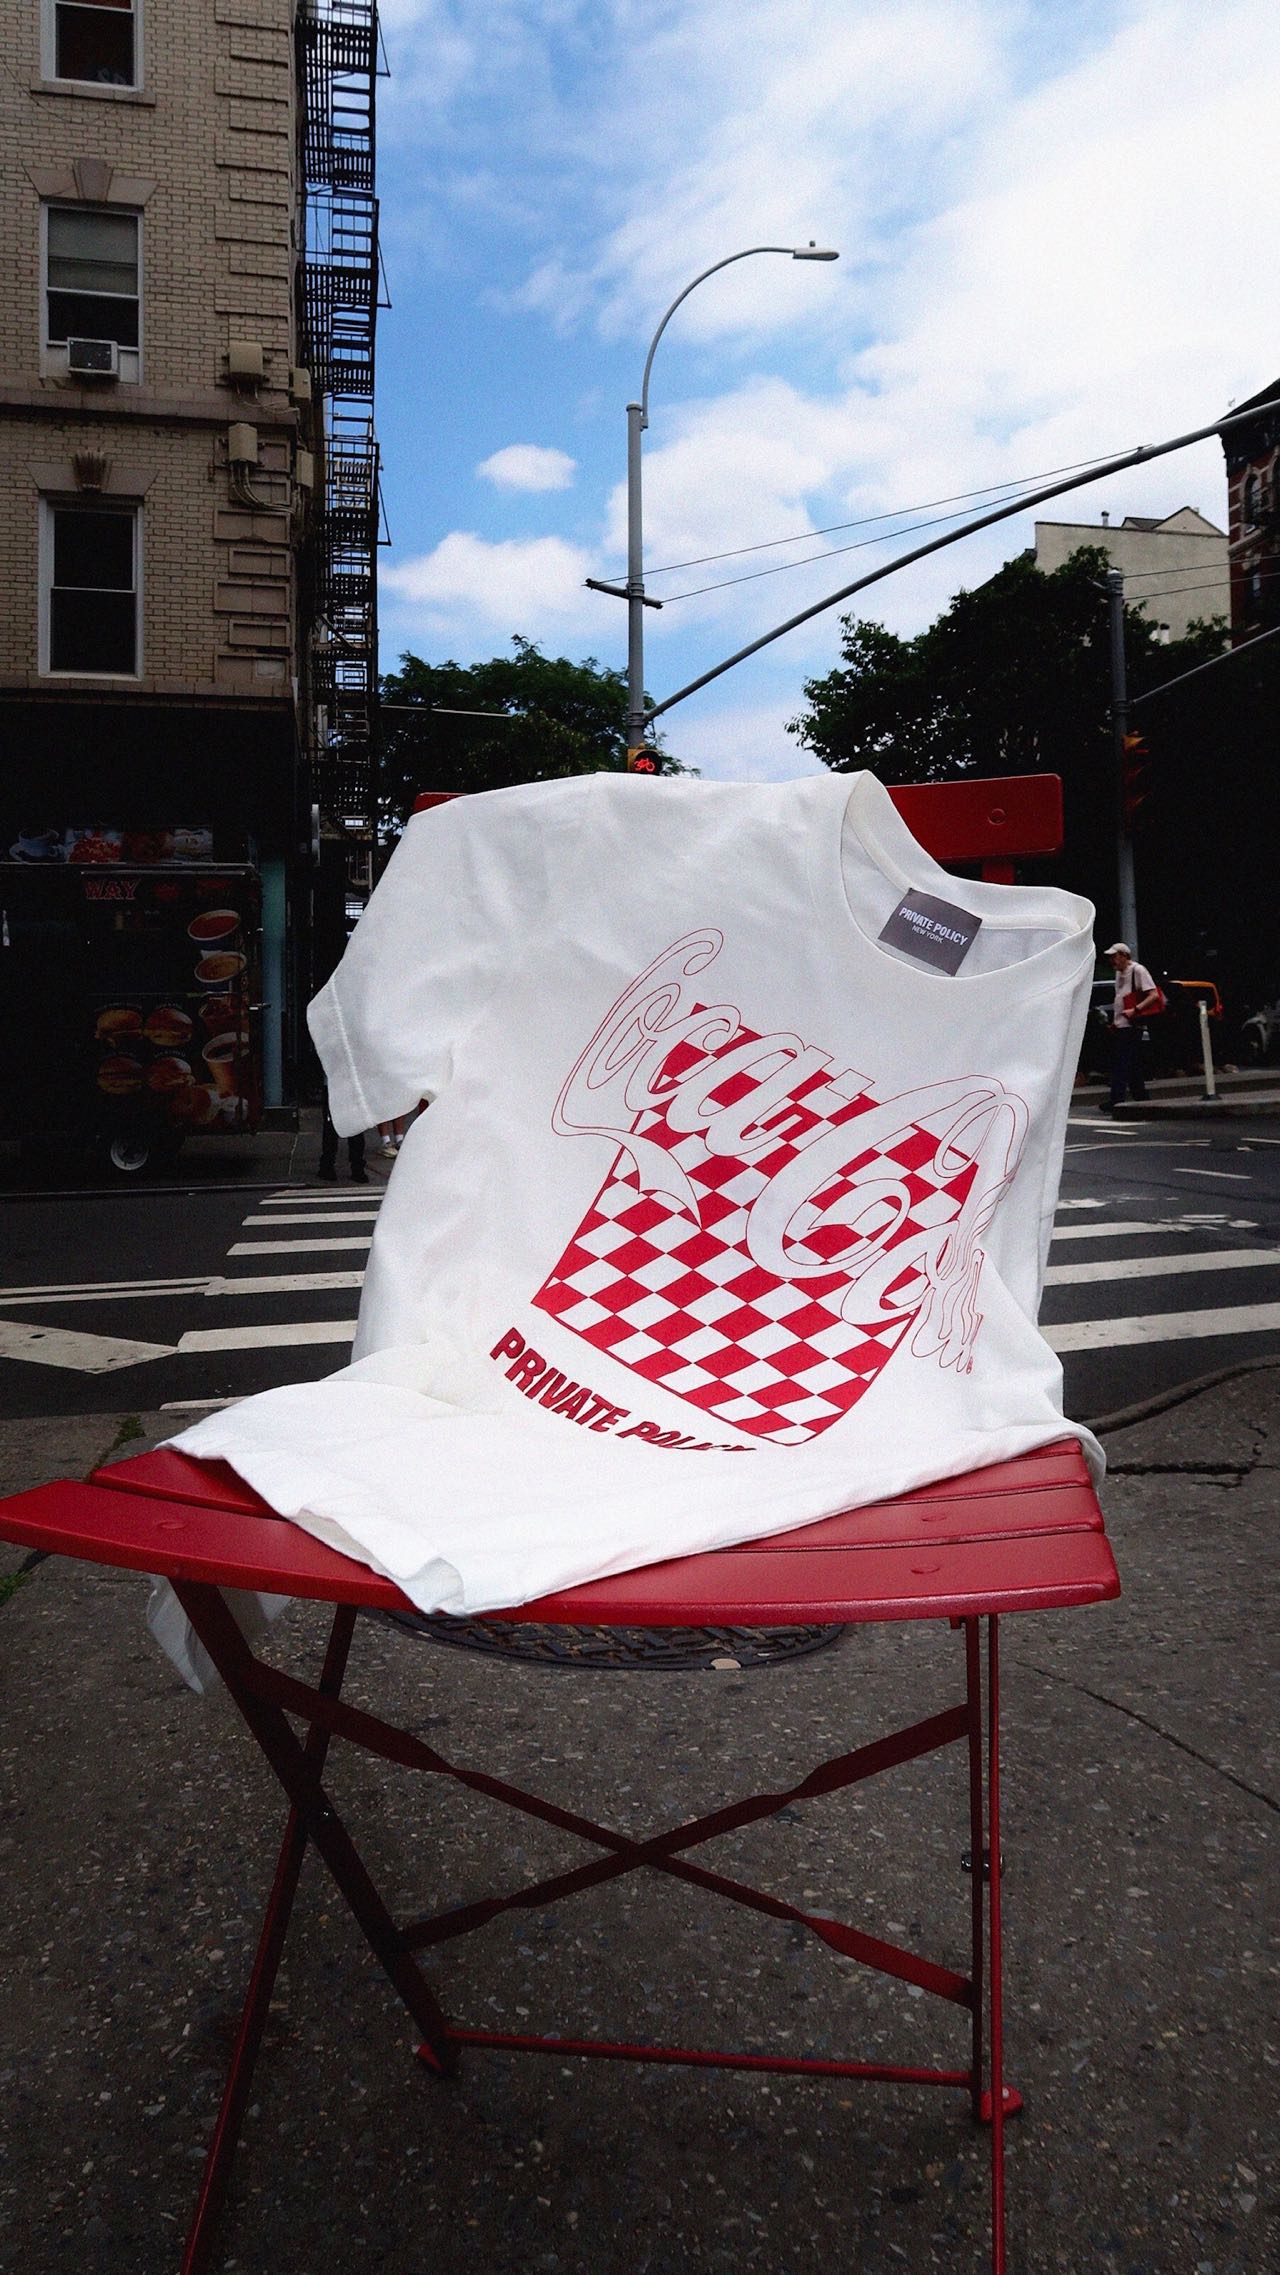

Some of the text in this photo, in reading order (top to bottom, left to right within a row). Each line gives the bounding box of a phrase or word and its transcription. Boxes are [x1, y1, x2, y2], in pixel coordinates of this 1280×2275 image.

[898, 907, 969, 946] PRIVATE POLICY
[911, 926, 944, 944] NEW YORK
[489, 1326, 632, 1433] PRIVATE
